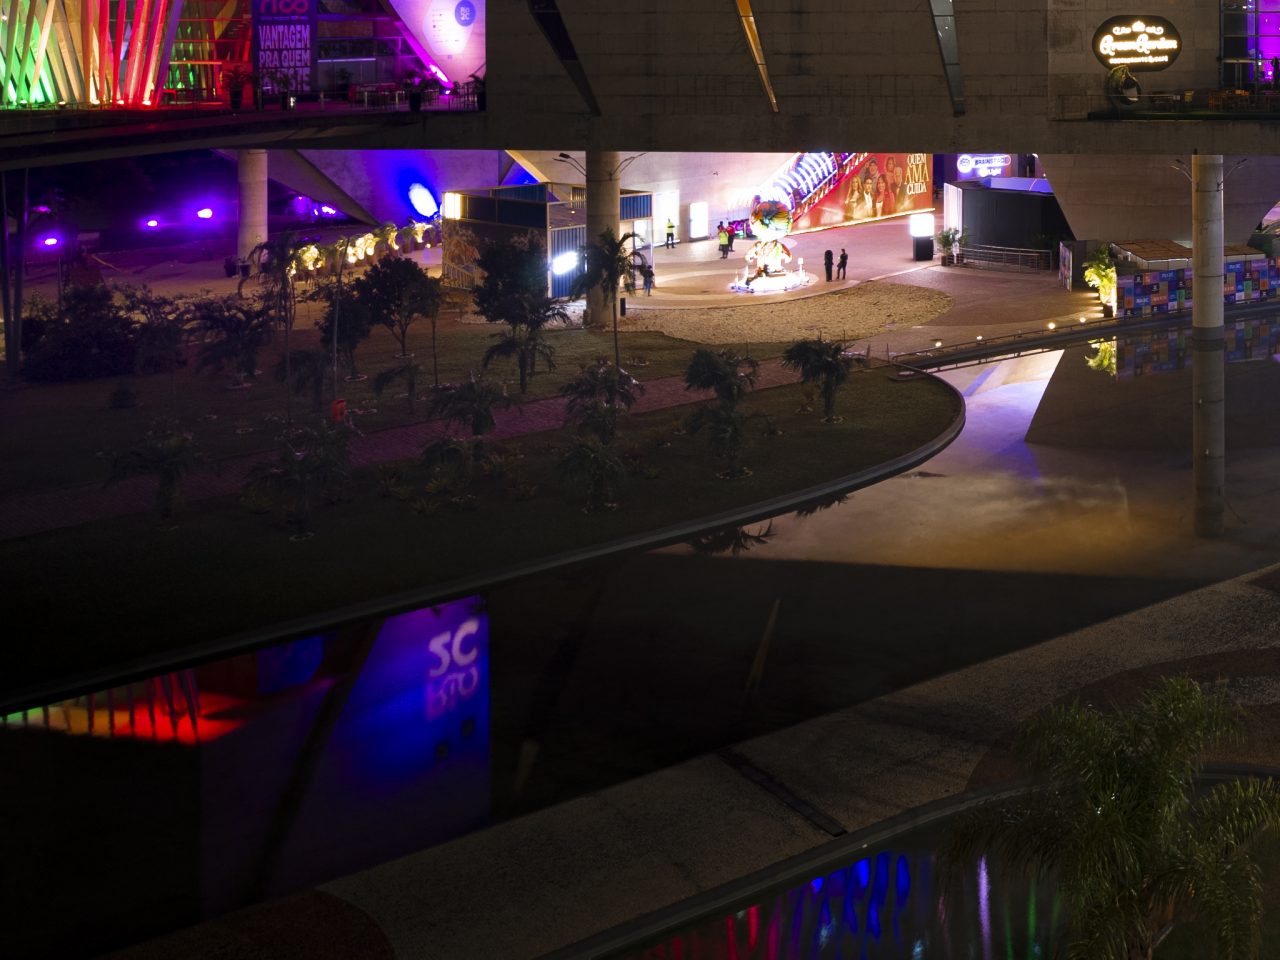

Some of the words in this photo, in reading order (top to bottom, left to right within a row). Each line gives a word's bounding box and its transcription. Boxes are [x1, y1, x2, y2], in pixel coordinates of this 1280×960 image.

[258, 25, 310, 49] VANTAGEM
[259, 51, 280, 67] PRA
[281, 50, 310, 68] QUEM
[907, 153, 927, 167] QUEM
[904, 164, 929, 184] AMA
[906, 180, 927, 195] CUIDA
